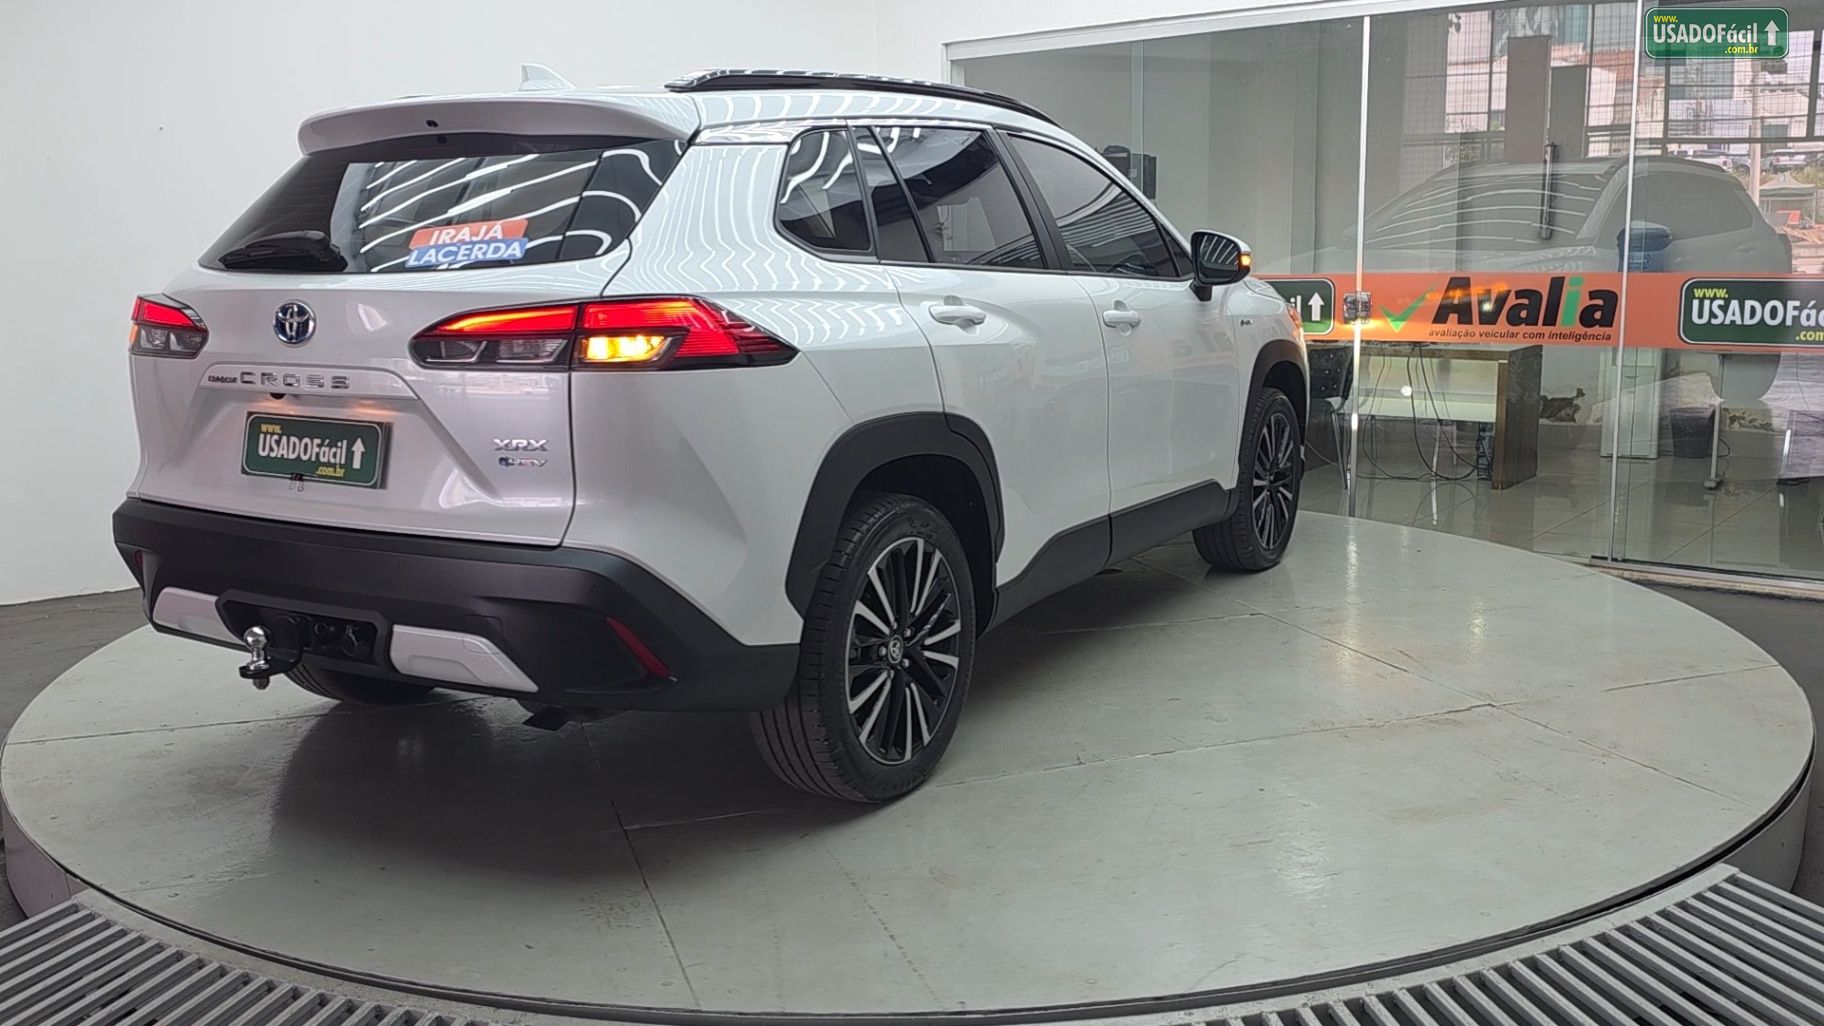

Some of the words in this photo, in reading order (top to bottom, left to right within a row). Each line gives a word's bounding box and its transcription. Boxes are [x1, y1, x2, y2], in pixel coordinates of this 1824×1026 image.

[407, 241, 521, 266] LACERDA
[1693, 288, 1729, 298] www.
[1431, 276, 1619, 329] Avalia
[1428, 329, 1476, 339] avaliação
[1478, 329, 1518, 339] veicular
[1522, 331, 1546, 340] com
[1548, 330, 1613, 343] inteligência
[239, 371, 350, 390] CROSS
[257, 433, 348, 465] USADOFácil
[493, 438, 548, 452] XRX
[315, 464, 346, 478] .com.br
